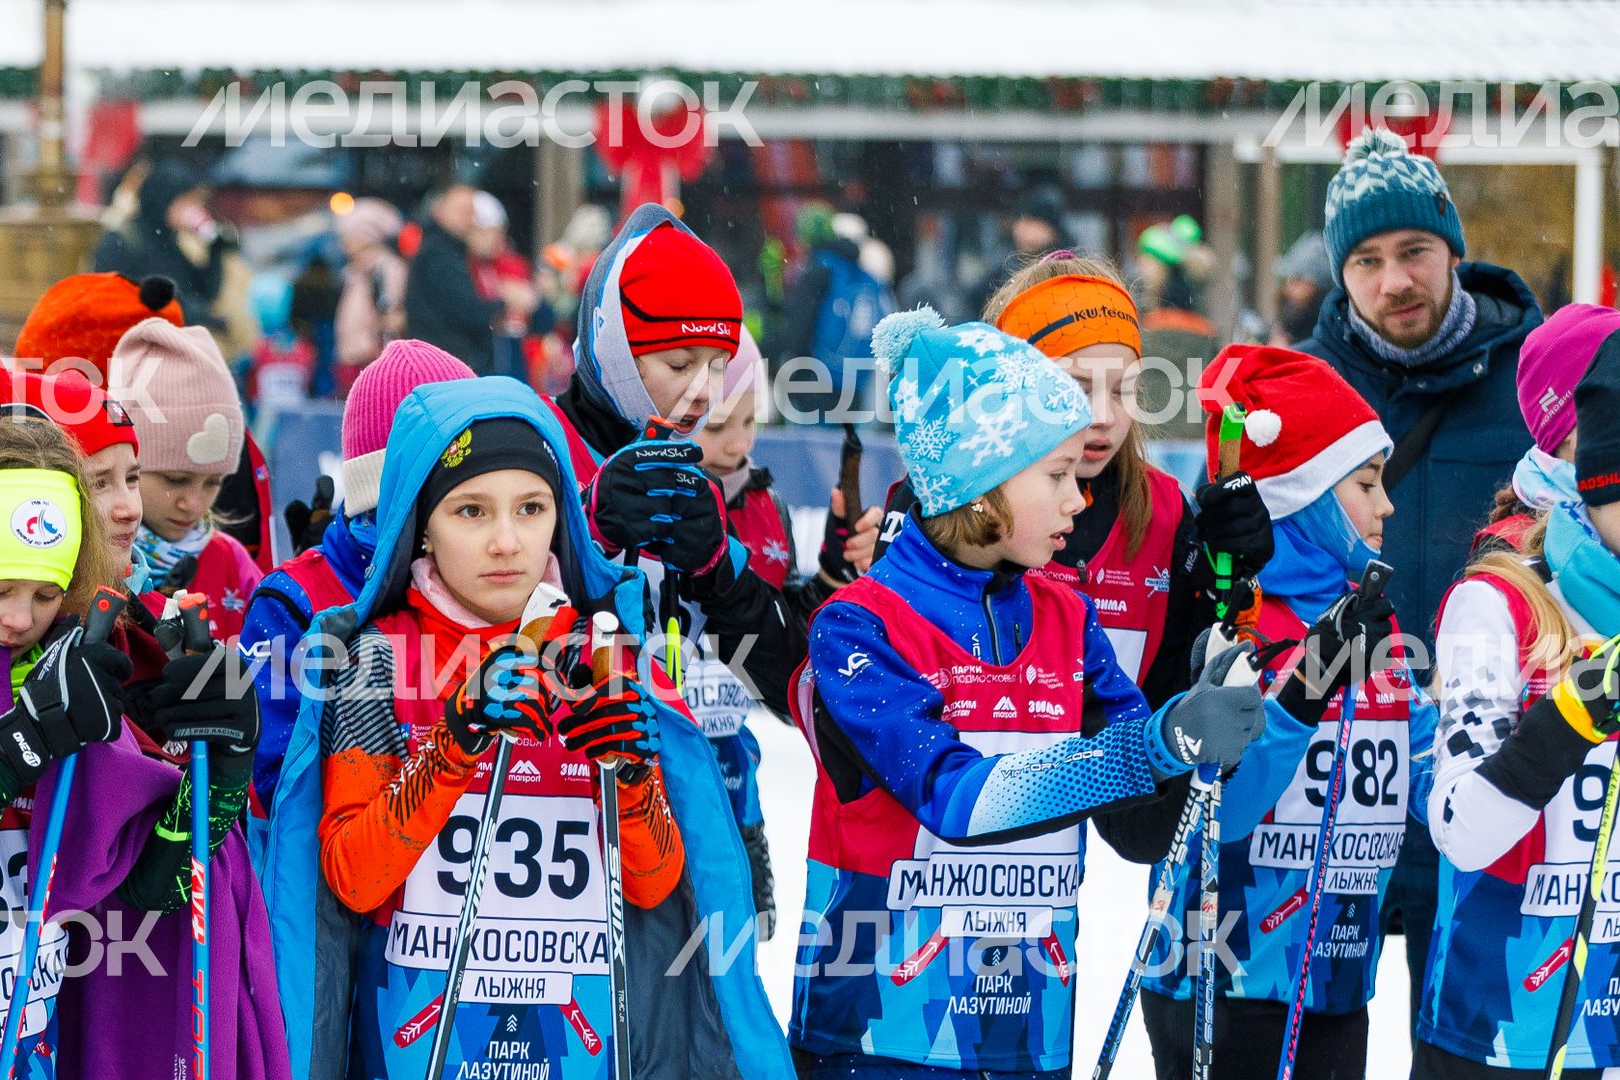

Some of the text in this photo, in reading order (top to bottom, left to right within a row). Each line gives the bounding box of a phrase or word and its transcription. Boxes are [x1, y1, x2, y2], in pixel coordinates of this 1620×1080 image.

[1304, 738, 1399, 808] 982
[436, 815, 590, 900] 935
[608, 843, 626, 968] SWIX
[962, 911, 1027, 933] ЛЫЖНЯ
[1330, 924, 1360, 941] ПАРК
[1312, 937, 1369, 958] АЗУТИНОЙ
[474, 975, 547, 1000] ЛЫЖНЯ
[975, 975, 1013, 994] ПАРК
[947, 990, 1032, 1016] ЛАЗУТИНОЙ
[487, 1040, 530, 1061] ПАРК
